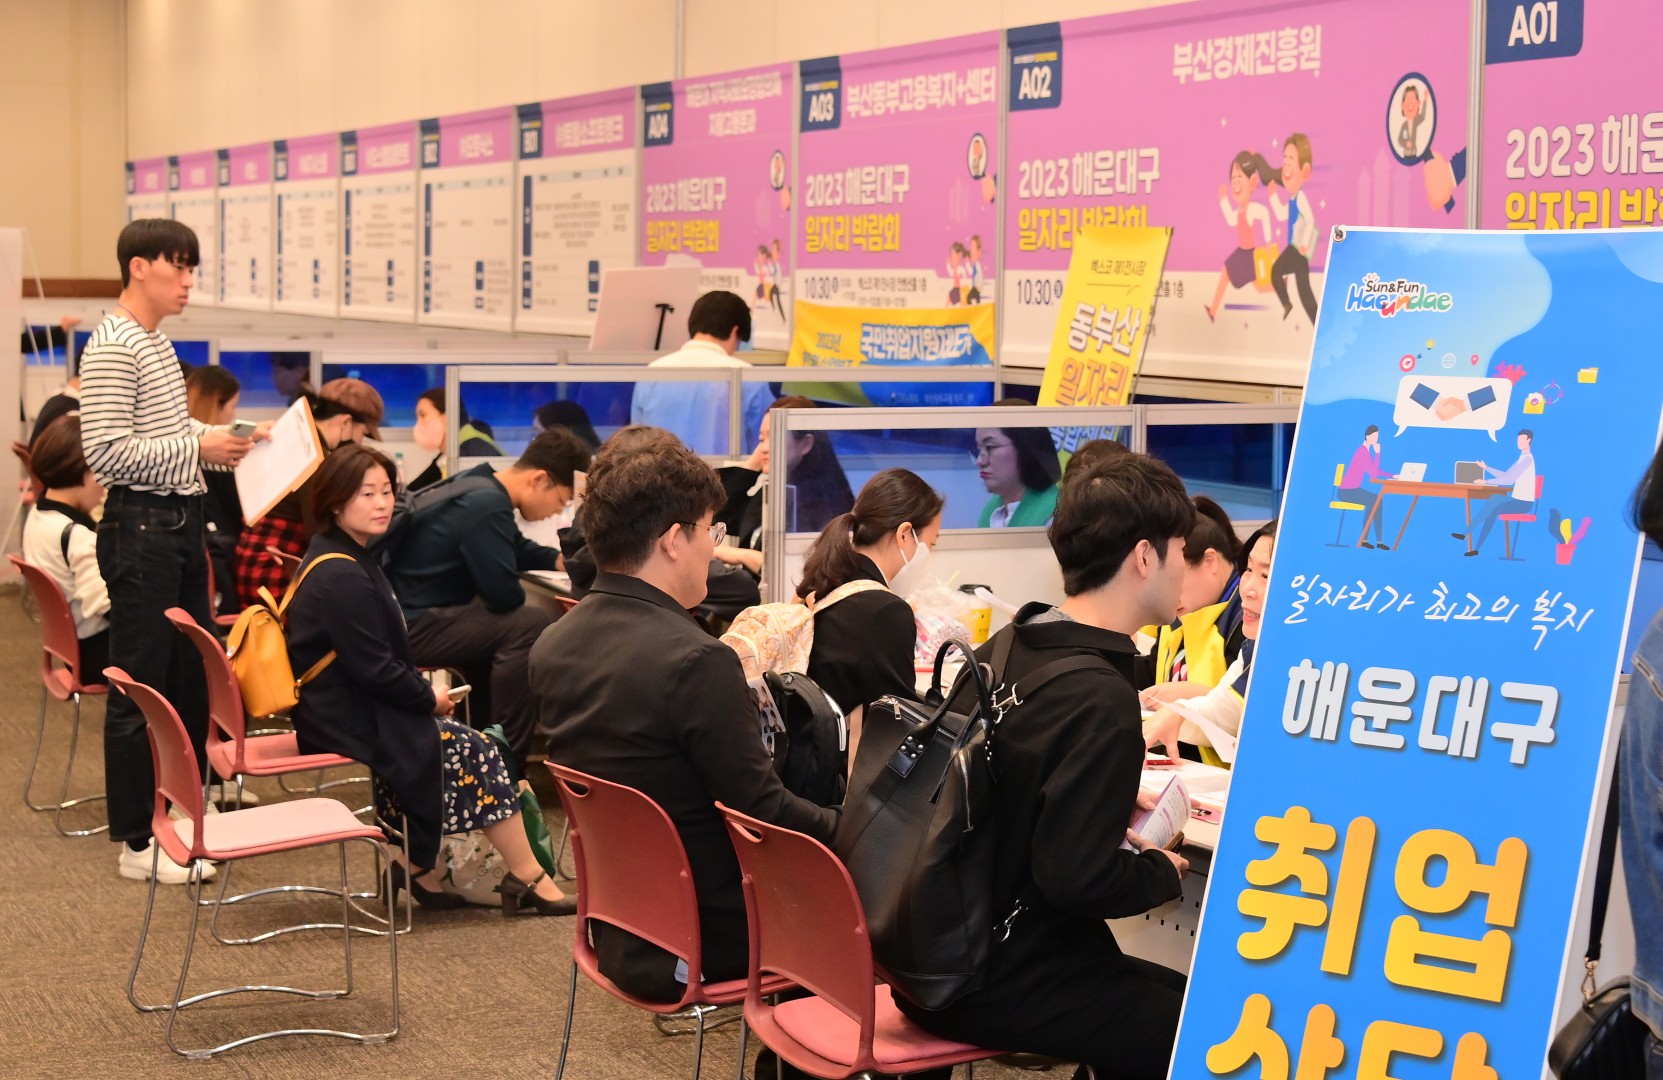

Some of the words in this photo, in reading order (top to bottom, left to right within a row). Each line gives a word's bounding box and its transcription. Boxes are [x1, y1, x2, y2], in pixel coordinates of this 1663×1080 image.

[1507, 1, 1558, 47] A01
[1173, 24, 1322, 84] 부산경제진흥원
[846, 67, 996, 118] 부산동부고용복지+센터
[1018, 65, 1052, 100] A02
[807, 93, 834, 123] A03
[1018, 157, 1070, 199] 2023
[1072, 147, 1160, 197] 해운대구
[1505, 123, 1596, 179] 2023
[646, 184, 676, 213] 2023
[677, 175, 728, 213] 해운대구
[805, 171, 844, 208] 2023
[844, 163, 910, 206] 해운대구
[1505, 187, 1611, 231] 일자리
[1619, 186, 1663, 230] 박
[646, 219, 681, 254] 일자리
[683, 219, 720, 254] 박람회
[805, 213, 850, 253] 일자리
[853, 212, 901, 253] 박람회
[1018, 206, 1078, 252] 일자리
[1346, 285, 1452, 316] Haeundae
[1365, 280, 1419, 293] Sun&Fun
[1068, 301, 1141, 356] 동부산
[1055, 357, 1129, 406] 일자리
[1283, 573, 1417, 626] 일자리가
[1423, 580, 1521, 624] 최고의
[1529, 589, 1597, 652] 복지
[1281, 657, 1562, 767] 해운대구
[1236, 804, 1528, 1004] 취업
